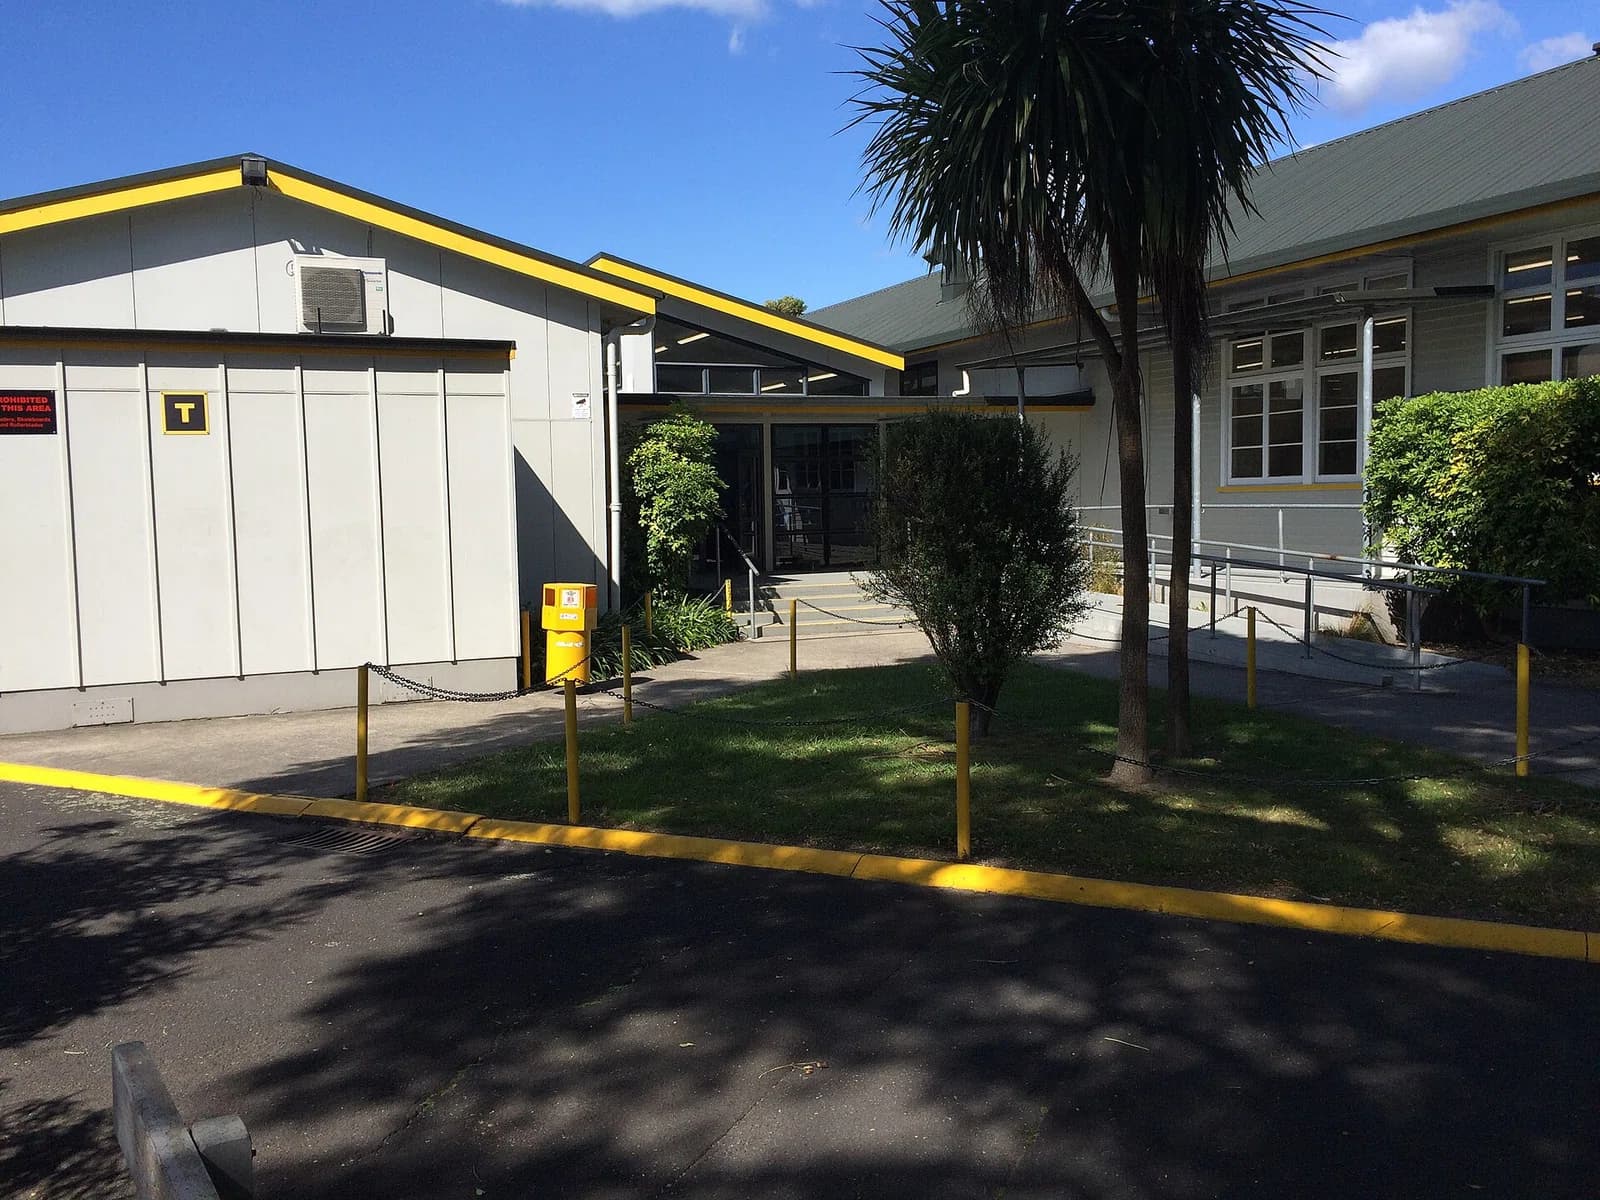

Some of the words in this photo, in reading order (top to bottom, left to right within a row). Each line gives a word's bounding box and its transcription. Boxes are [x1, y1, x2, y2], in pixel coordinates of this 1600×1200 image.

[1, 404, 23, 412] THIS
[26, 404, 52, 412] AREA
[174, 402, 195, 423] T
